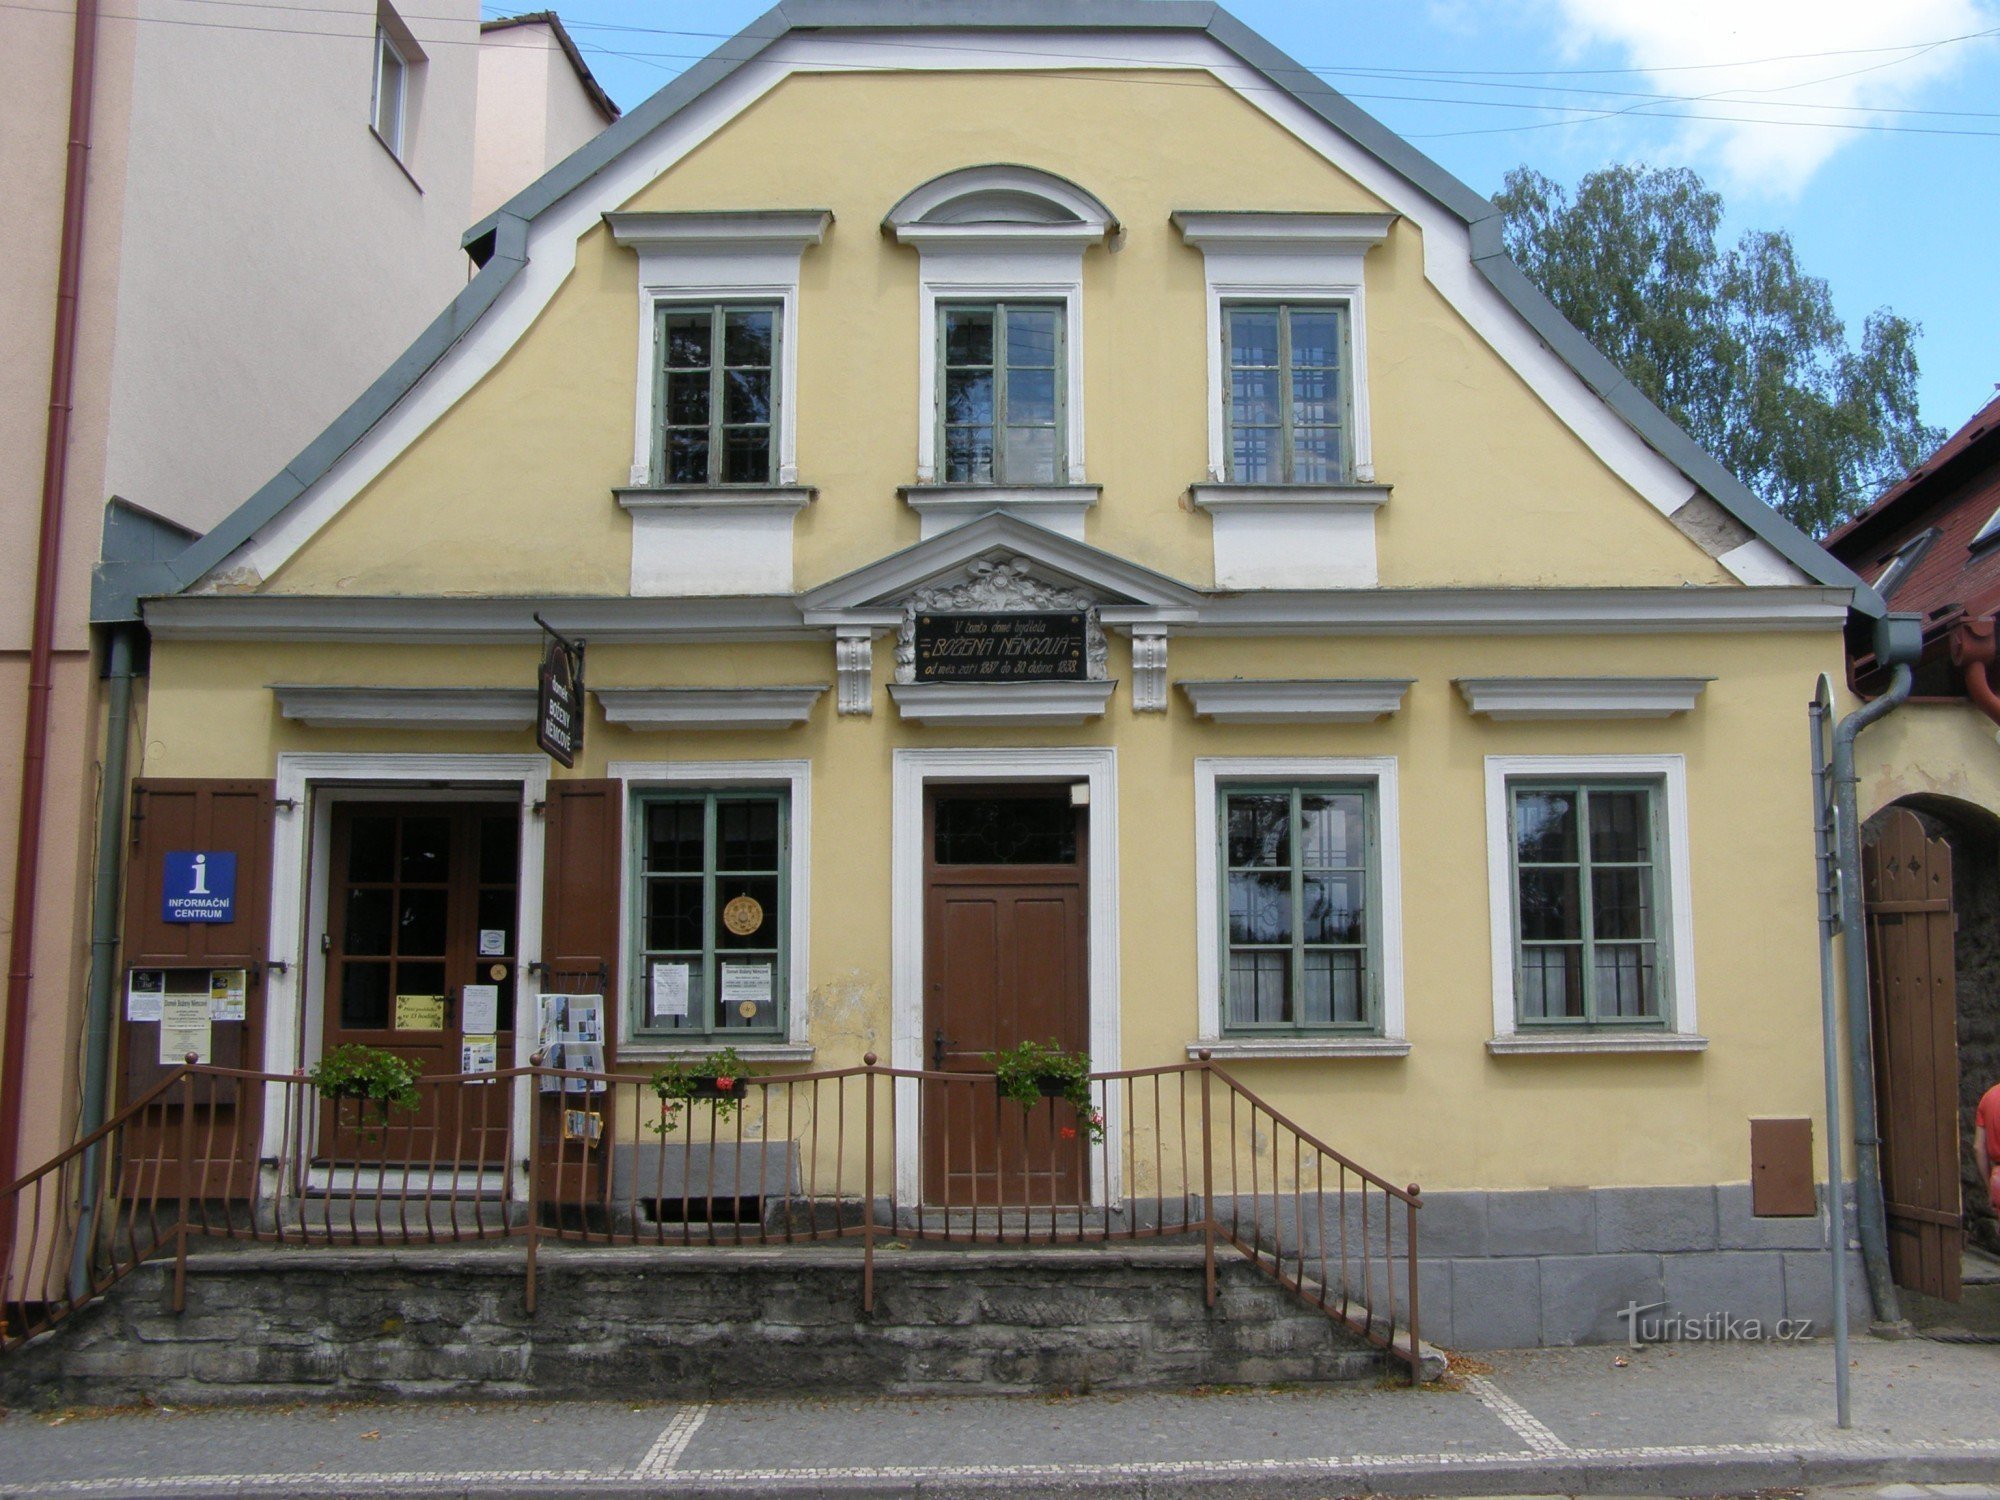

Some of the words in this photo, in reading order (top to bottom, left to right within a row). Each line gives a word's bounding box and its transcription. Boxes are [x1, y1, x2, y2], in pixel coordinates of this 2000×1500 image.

[955, 620, 962, 633] V
[965, 621, 988, 632] tomto
[932, 636, 995, 656] BOŽENA
[999, 634, 1070, 656] NĚMCOVÁ
[925, 661, 938, 675] od
[980, 661, 999, 674] 1837
[1001, 661, 1011, 674] do
[1027, 660, 1053, 674] dubna
[549, 698, 571, 728] BOŽENY
[545, 717, 571, 752] NĚMCOVÉ
[189, 854, 210, 894] i
[168, 898, 230, 907] INFORMAČNÍ
[174, 909, 222, 918] CENTRUM
